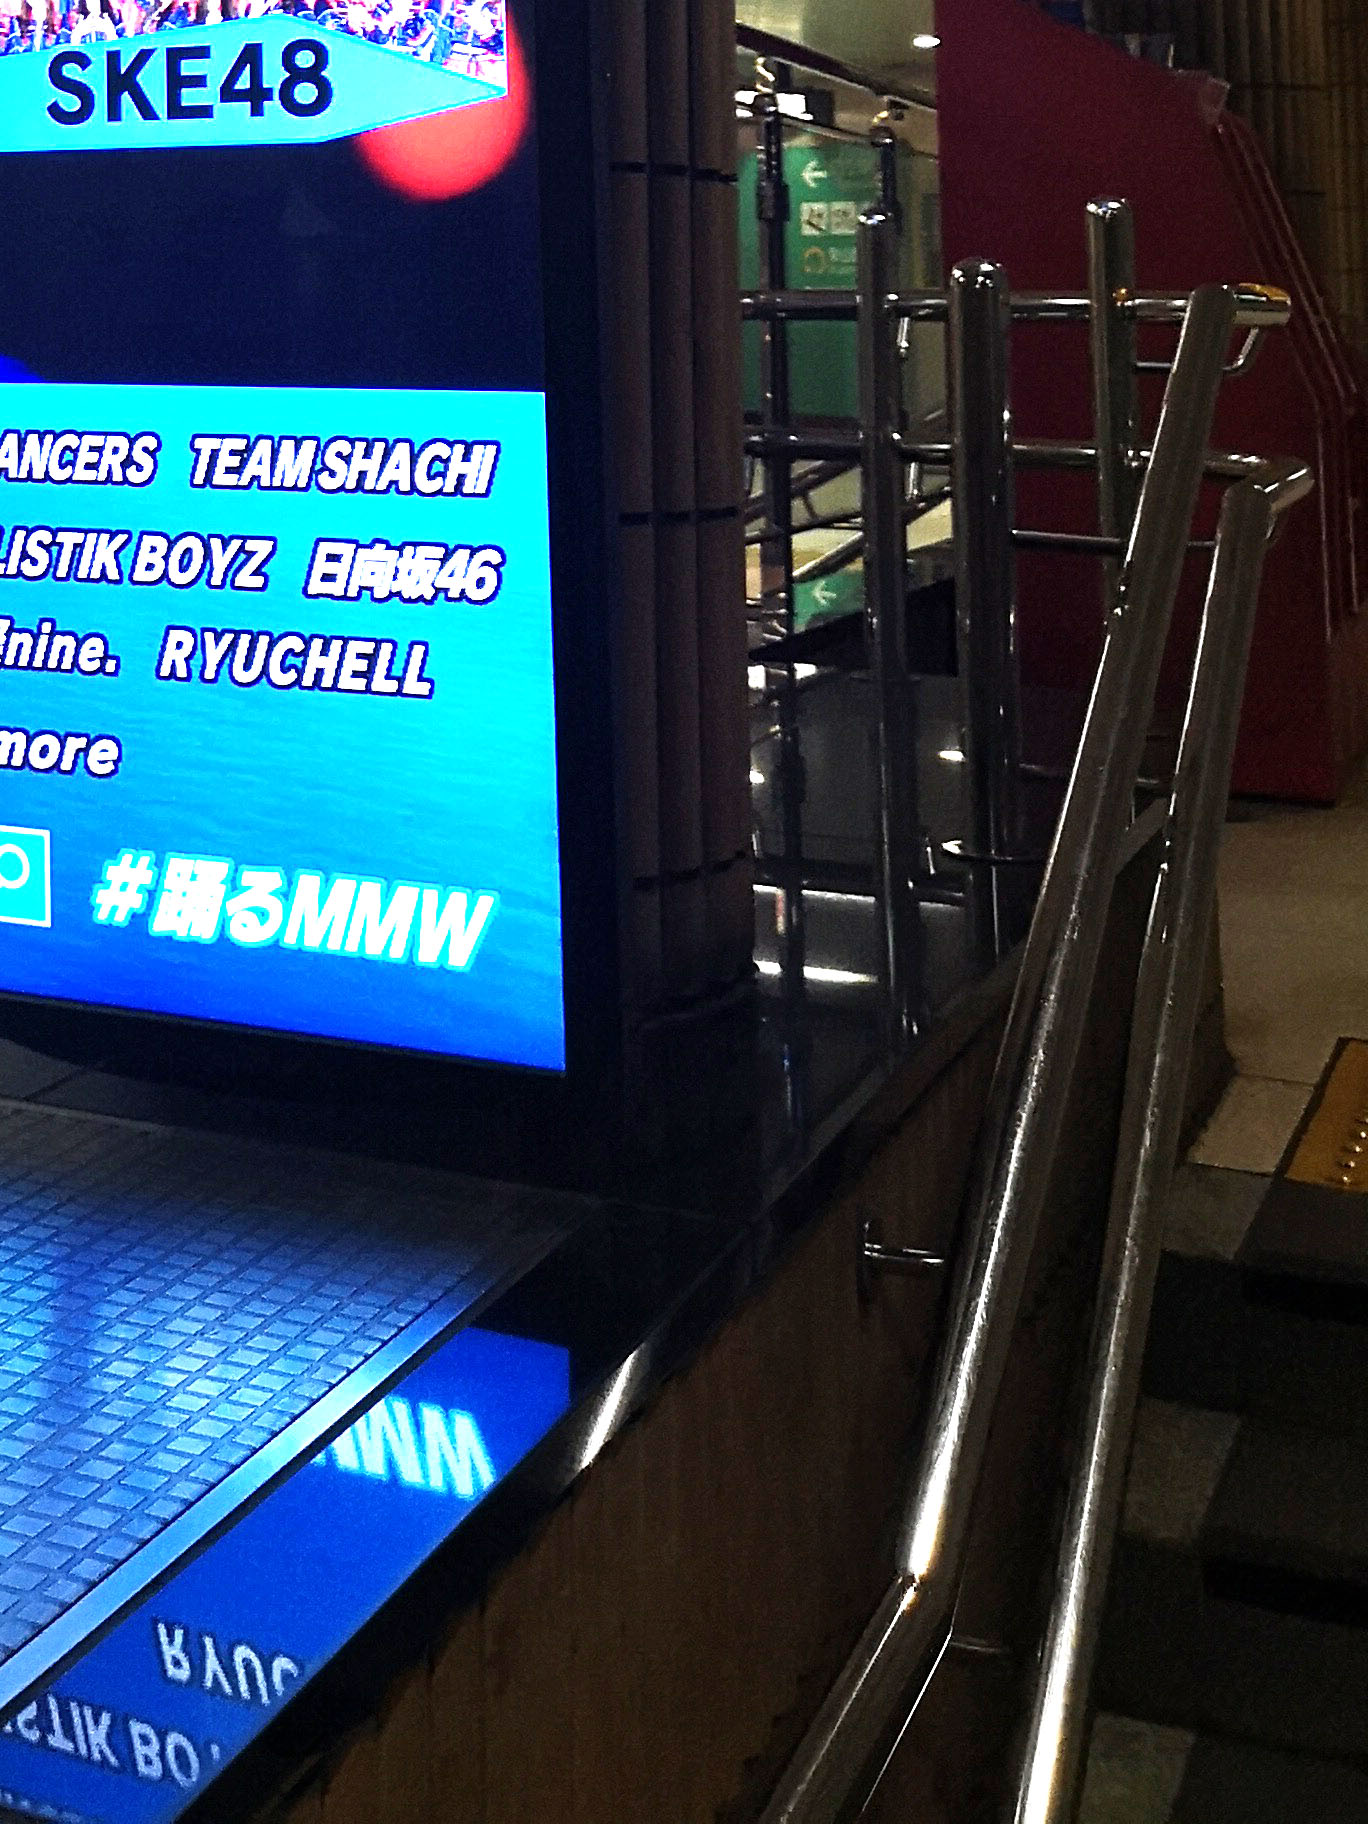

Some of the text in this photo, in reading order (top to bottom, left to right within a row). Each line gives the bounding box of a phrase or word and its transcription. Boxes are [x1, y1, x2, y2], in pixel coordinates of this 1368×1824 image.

[46, 37, 335, 127] SKE48
[189, 435, 322, 489] TEAM
[318, 438, 499, 497] SHACHI
[132, 533, 277, 590] BOYZ
[305, 539, 505, 605] 日向坂46
[158, 626, 434, 698] RYUCHELL
